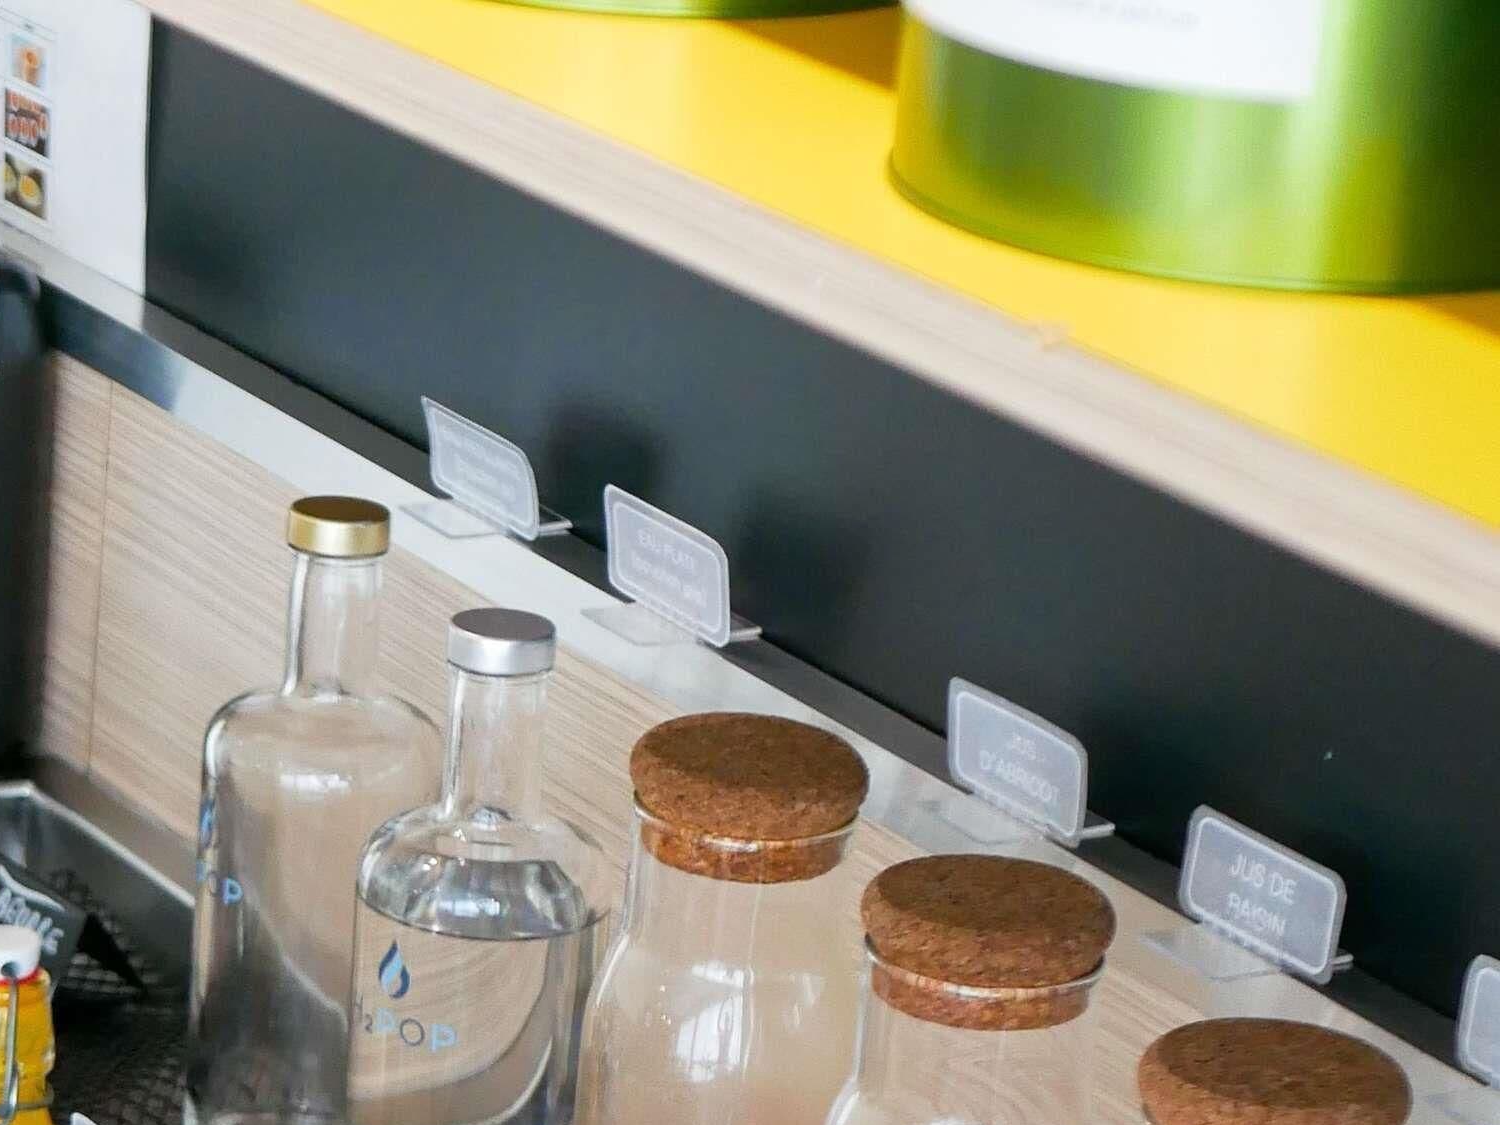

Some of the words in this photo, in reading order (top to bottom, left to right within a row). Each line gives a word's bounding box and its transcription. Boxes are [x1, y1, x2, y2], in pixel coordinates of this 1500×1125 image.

[1231, 853, 1266, 888] JUS
[1269, 870, 1298, 905] DE
[1227, 891, 1287, 937] RAISIN
